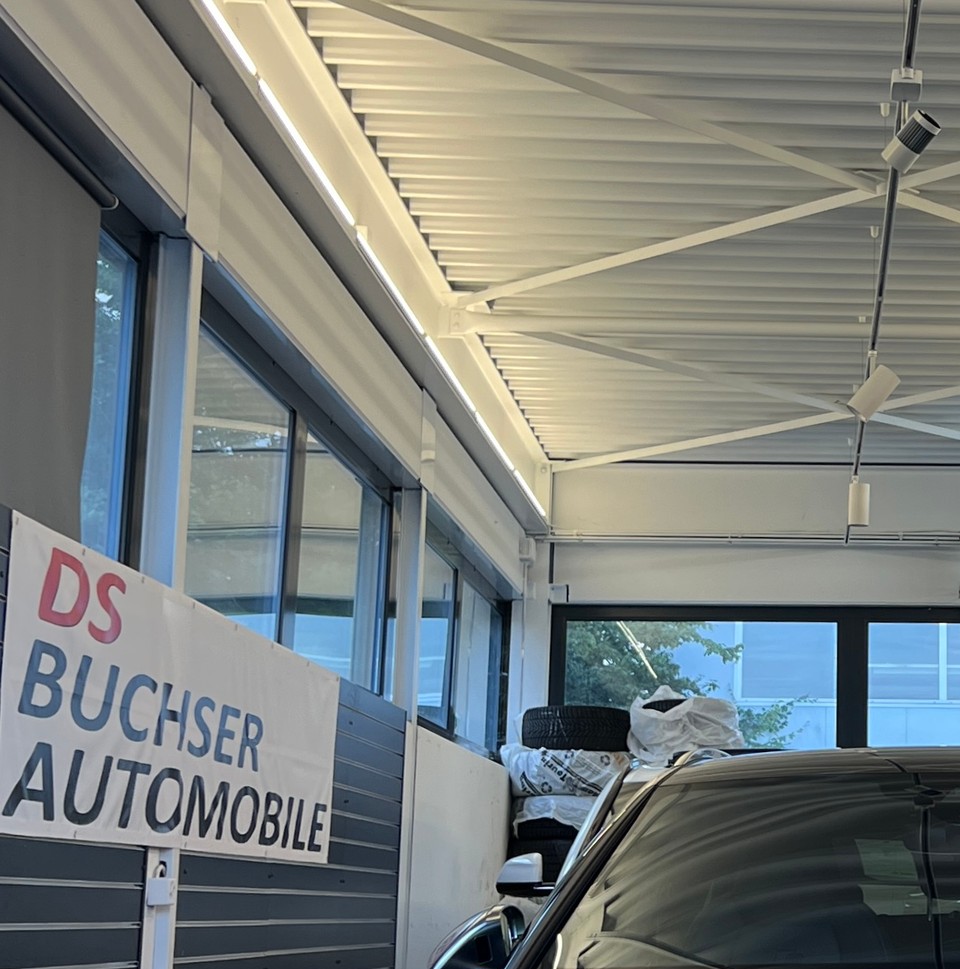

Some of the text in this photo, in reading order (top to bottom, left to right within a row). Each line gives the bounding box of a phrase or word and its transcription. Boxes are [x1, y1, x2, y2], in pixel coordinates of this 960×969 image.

[38, 547, 127, 644] DS
[17, 639, 264, 772] BUCHSER
[2, 742, 328, 852] AUTOMOBILE
